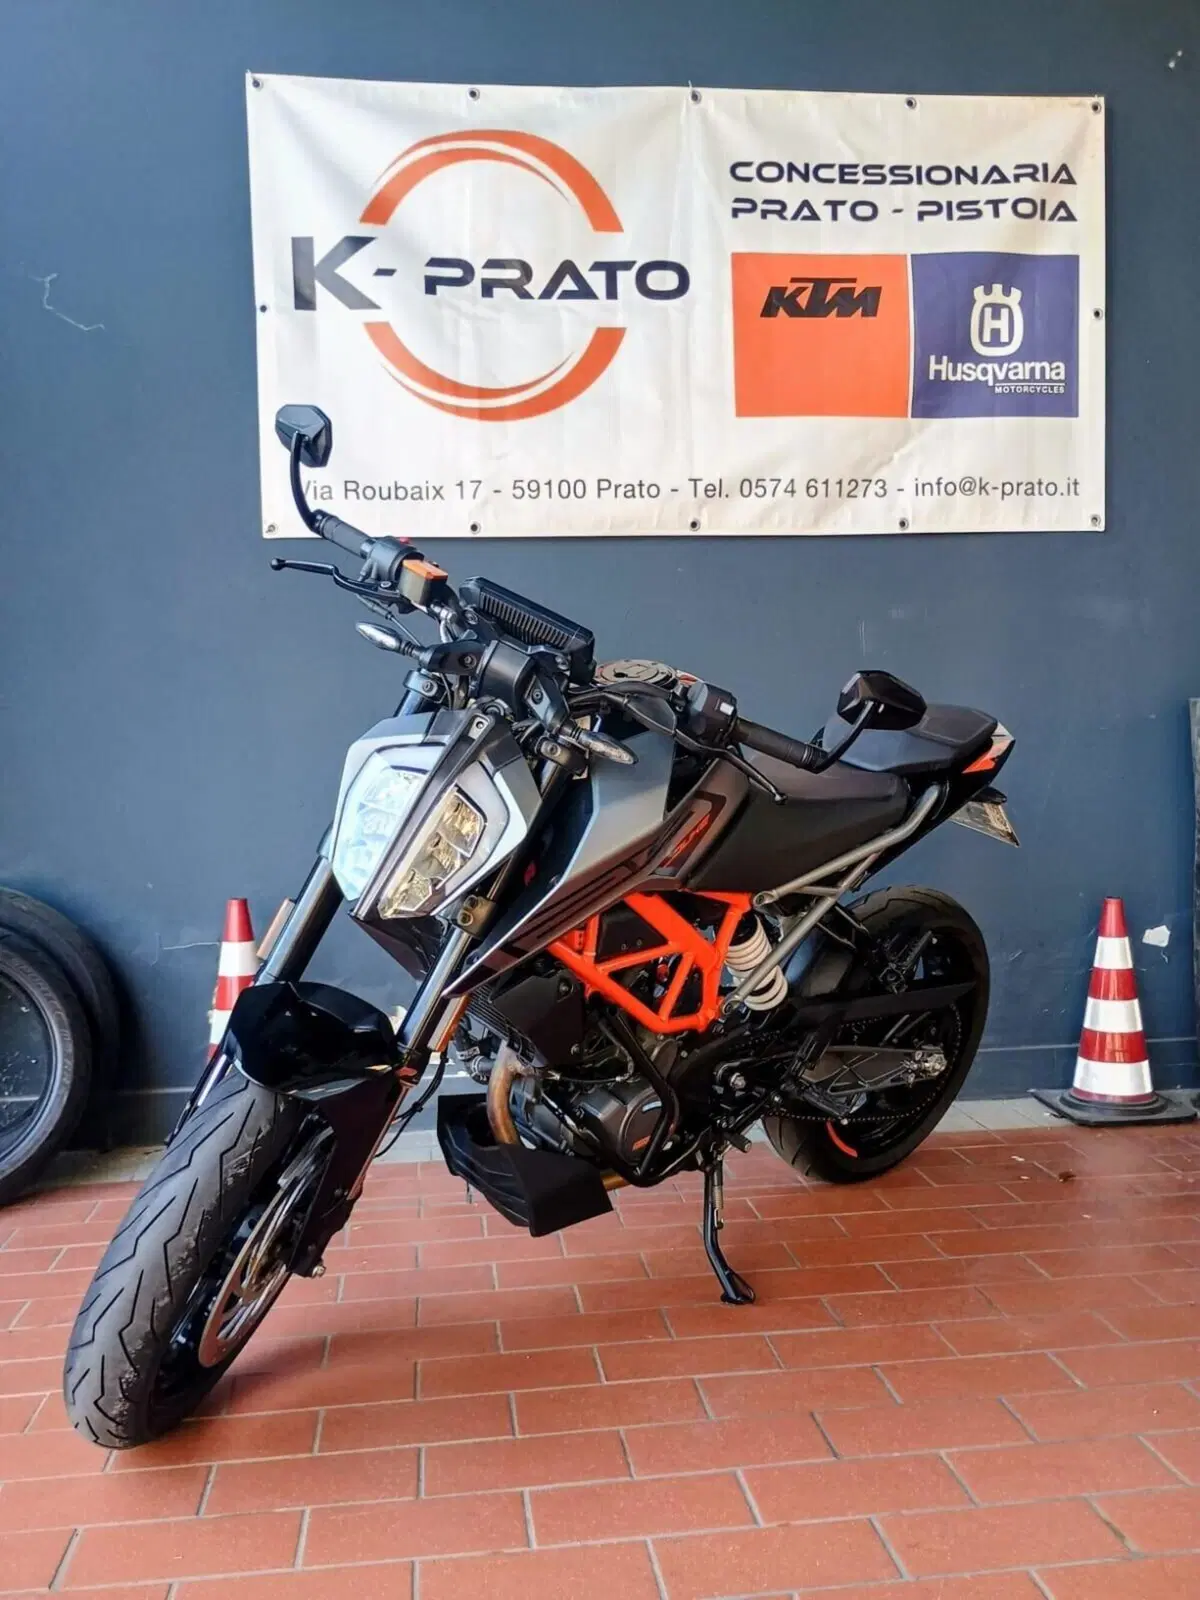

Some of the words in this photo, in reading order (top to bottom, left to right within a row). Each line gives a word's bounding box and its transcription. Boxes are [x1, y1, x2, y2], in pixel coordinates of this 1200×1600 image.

[729, 161, 1077, 186] CONCESSIONARIA
[731, 197, 879, 222] PRATO
[917, 197, 1078, 222] PISTOIA
[424, 257, 690, 300] PRATO
[760, 277, 882, 318] KTM
[929, 355, 1066, 386] Husqvarna
[994, 386, 1065, 394] MOTORCYCLES
[344, 480, 444, 500] Roubaix
[456, 480, 482, 500] 17
[512, 480, 586, 500] 59100
[597, 479, 661, 499] Prato
[688, 478, 729, 499] Tel.
[740, 478, 797, 499] 0574
[806, 478, 888, 499] 611273
[915, 475, 1080, 501] info@k-prato.it
